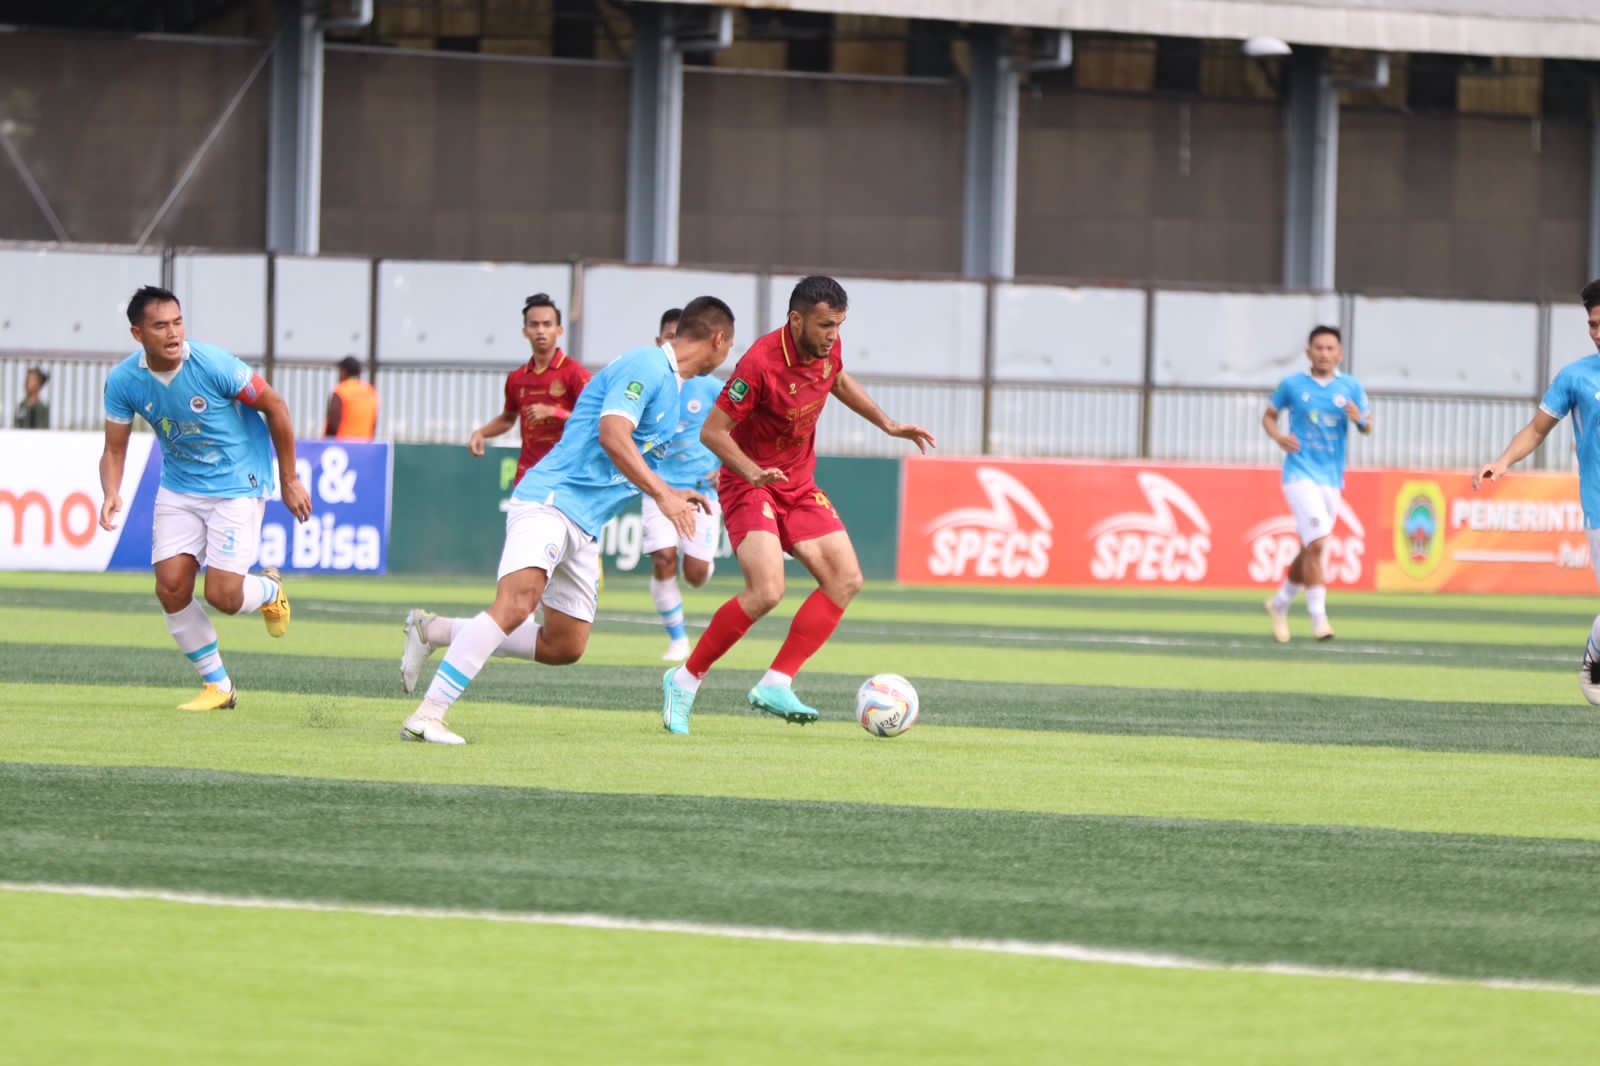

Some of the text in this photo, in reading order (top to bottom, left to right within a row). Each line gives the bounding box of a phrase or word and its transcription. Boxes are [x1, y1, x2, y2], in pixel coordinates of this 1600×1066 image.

[318, 446, 357, 504] &
[259, 512, 380, 570] a Bisa
[599, 514, 642, 571] ng
[929, 528, 1052, 578] SPECS
[1090, 532, 1210, 581] SPECS
[1248, 535, 1365, 583] SPCS
